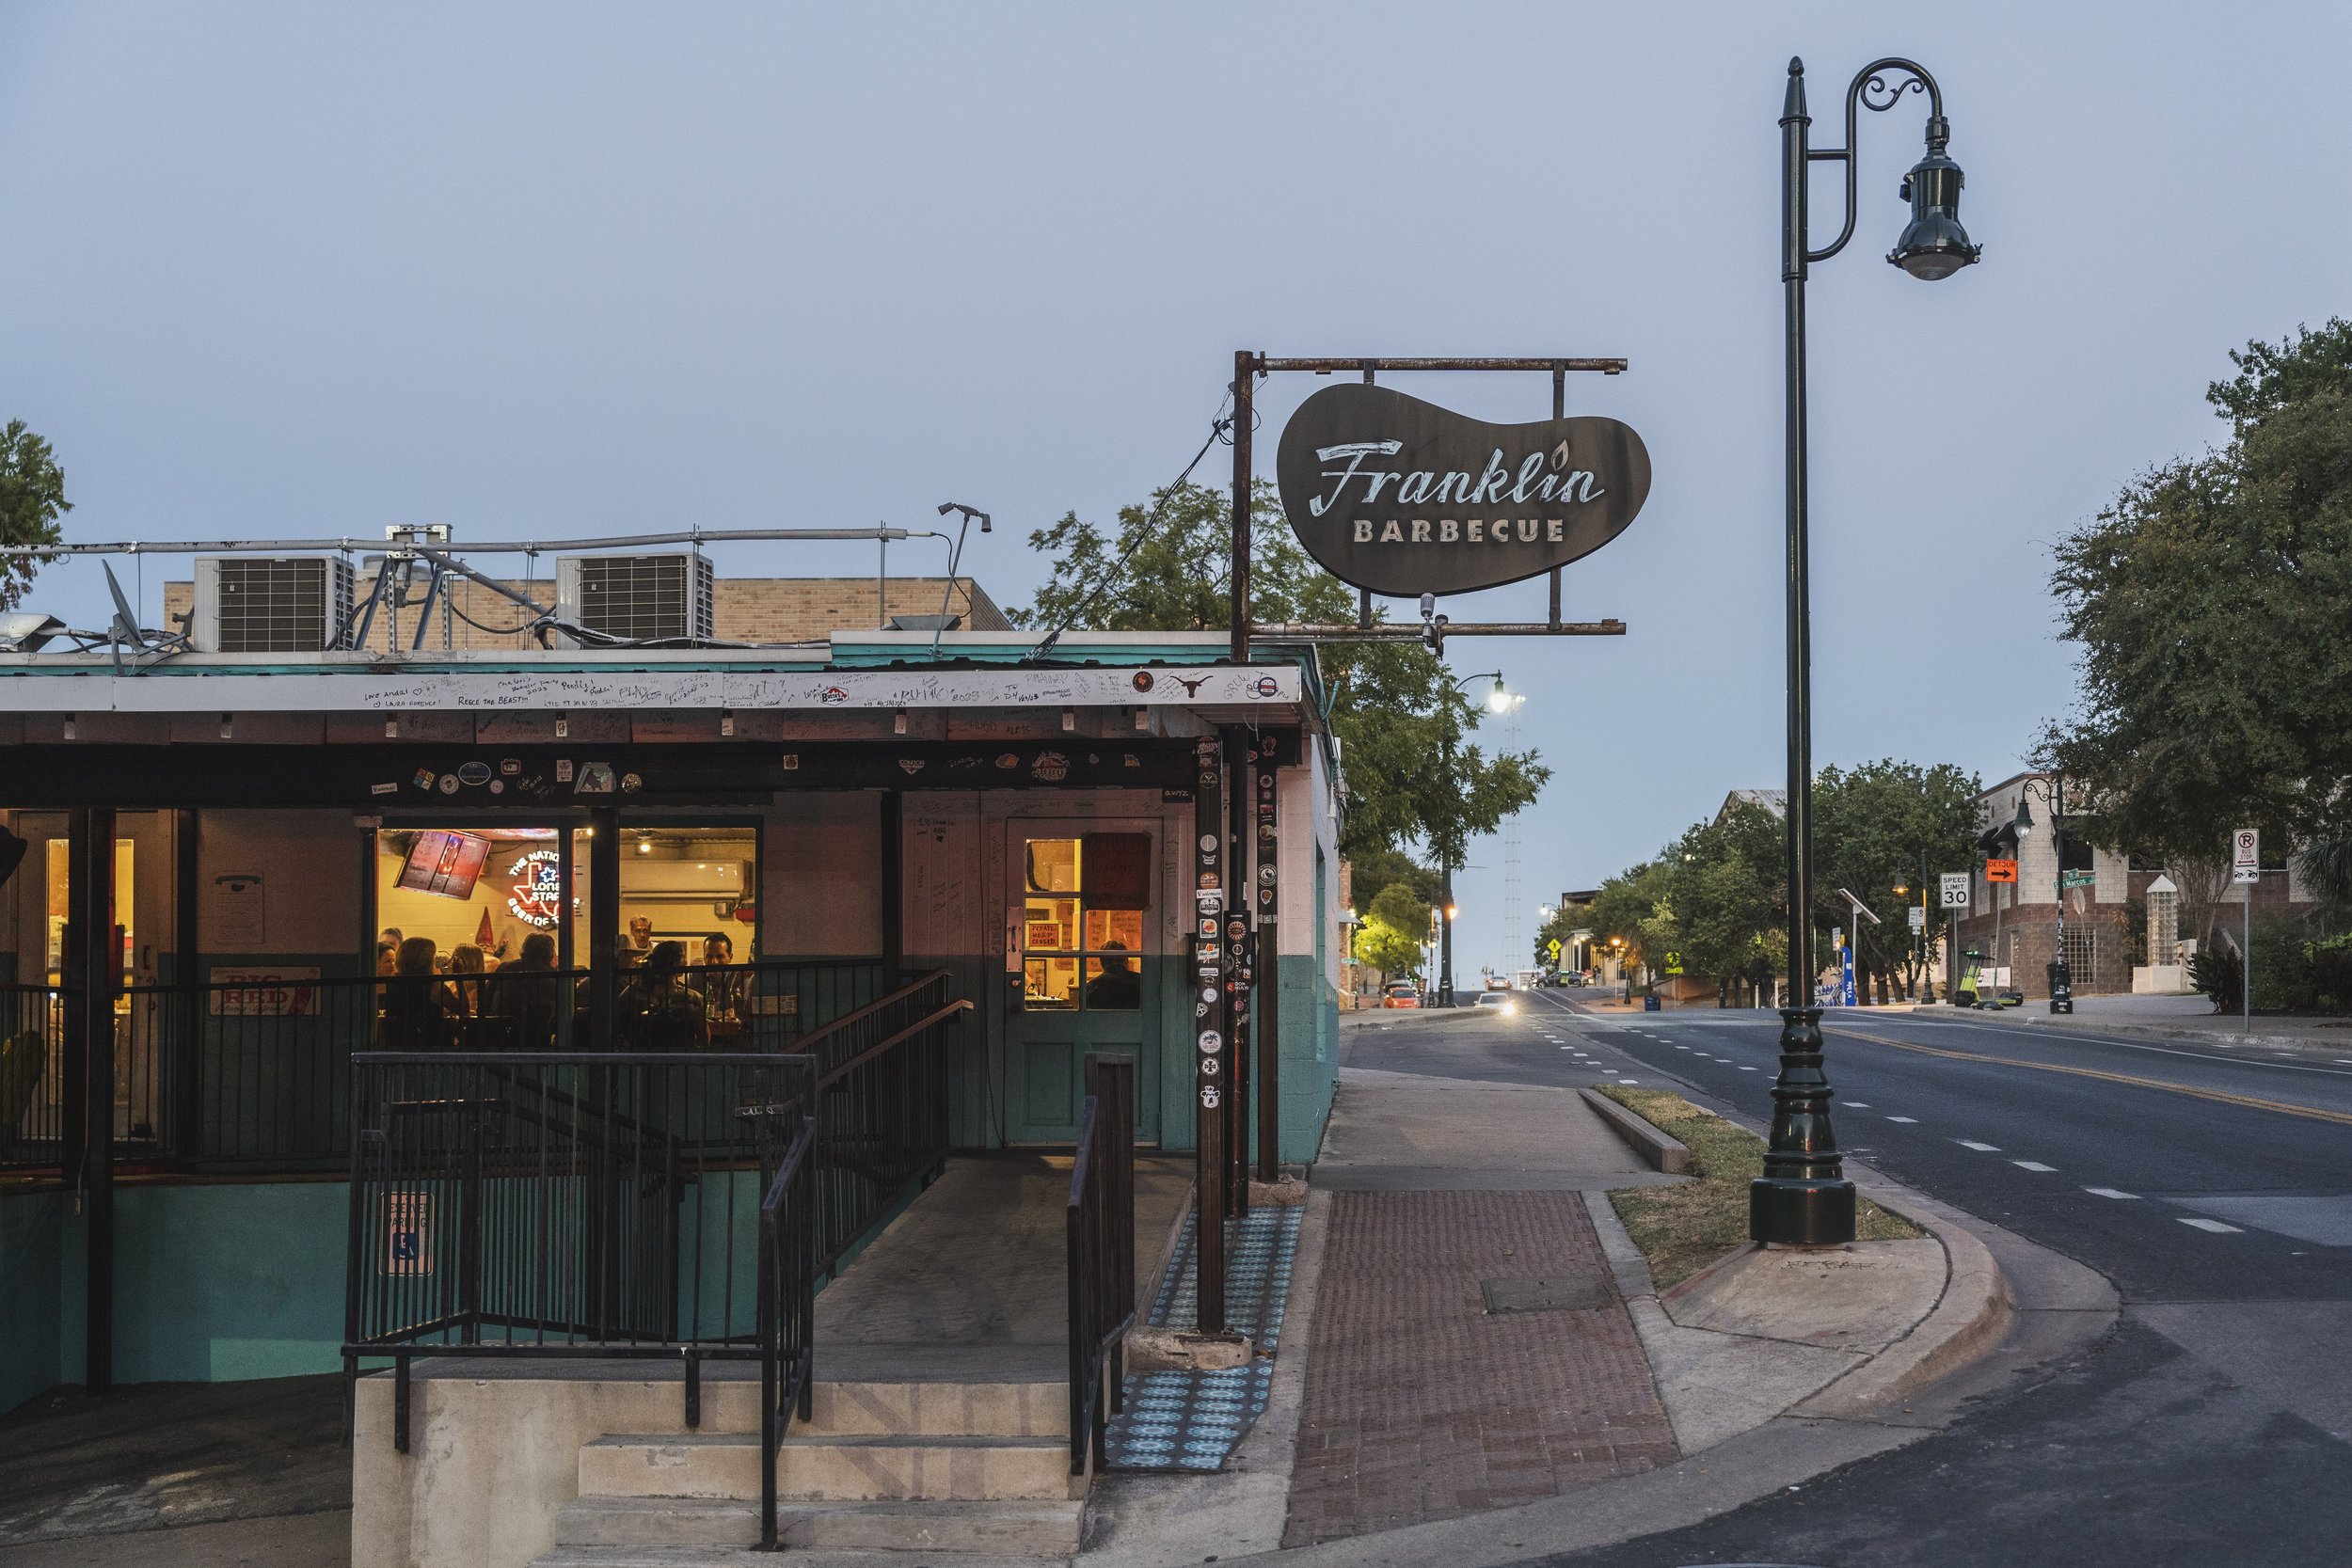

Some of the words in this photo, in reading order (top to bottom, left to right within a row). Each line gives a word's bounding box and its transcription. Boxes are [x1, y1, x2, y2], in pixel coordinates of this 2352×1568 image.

[1309, 438, 1605, 517] Franklin
[1354, 518, 1565, 543] BARBECUE
[509, 857, 528, 876] THE
[528, 850, 559, 863] NATIO
[2066, 879, 2086, 887] Marcos
[1944, 891, 1967, 904] 30
[508, 897, 533, 924] BEER
[533, 916, 549, 927] OF
[225, 990, 289, 1003] RED
